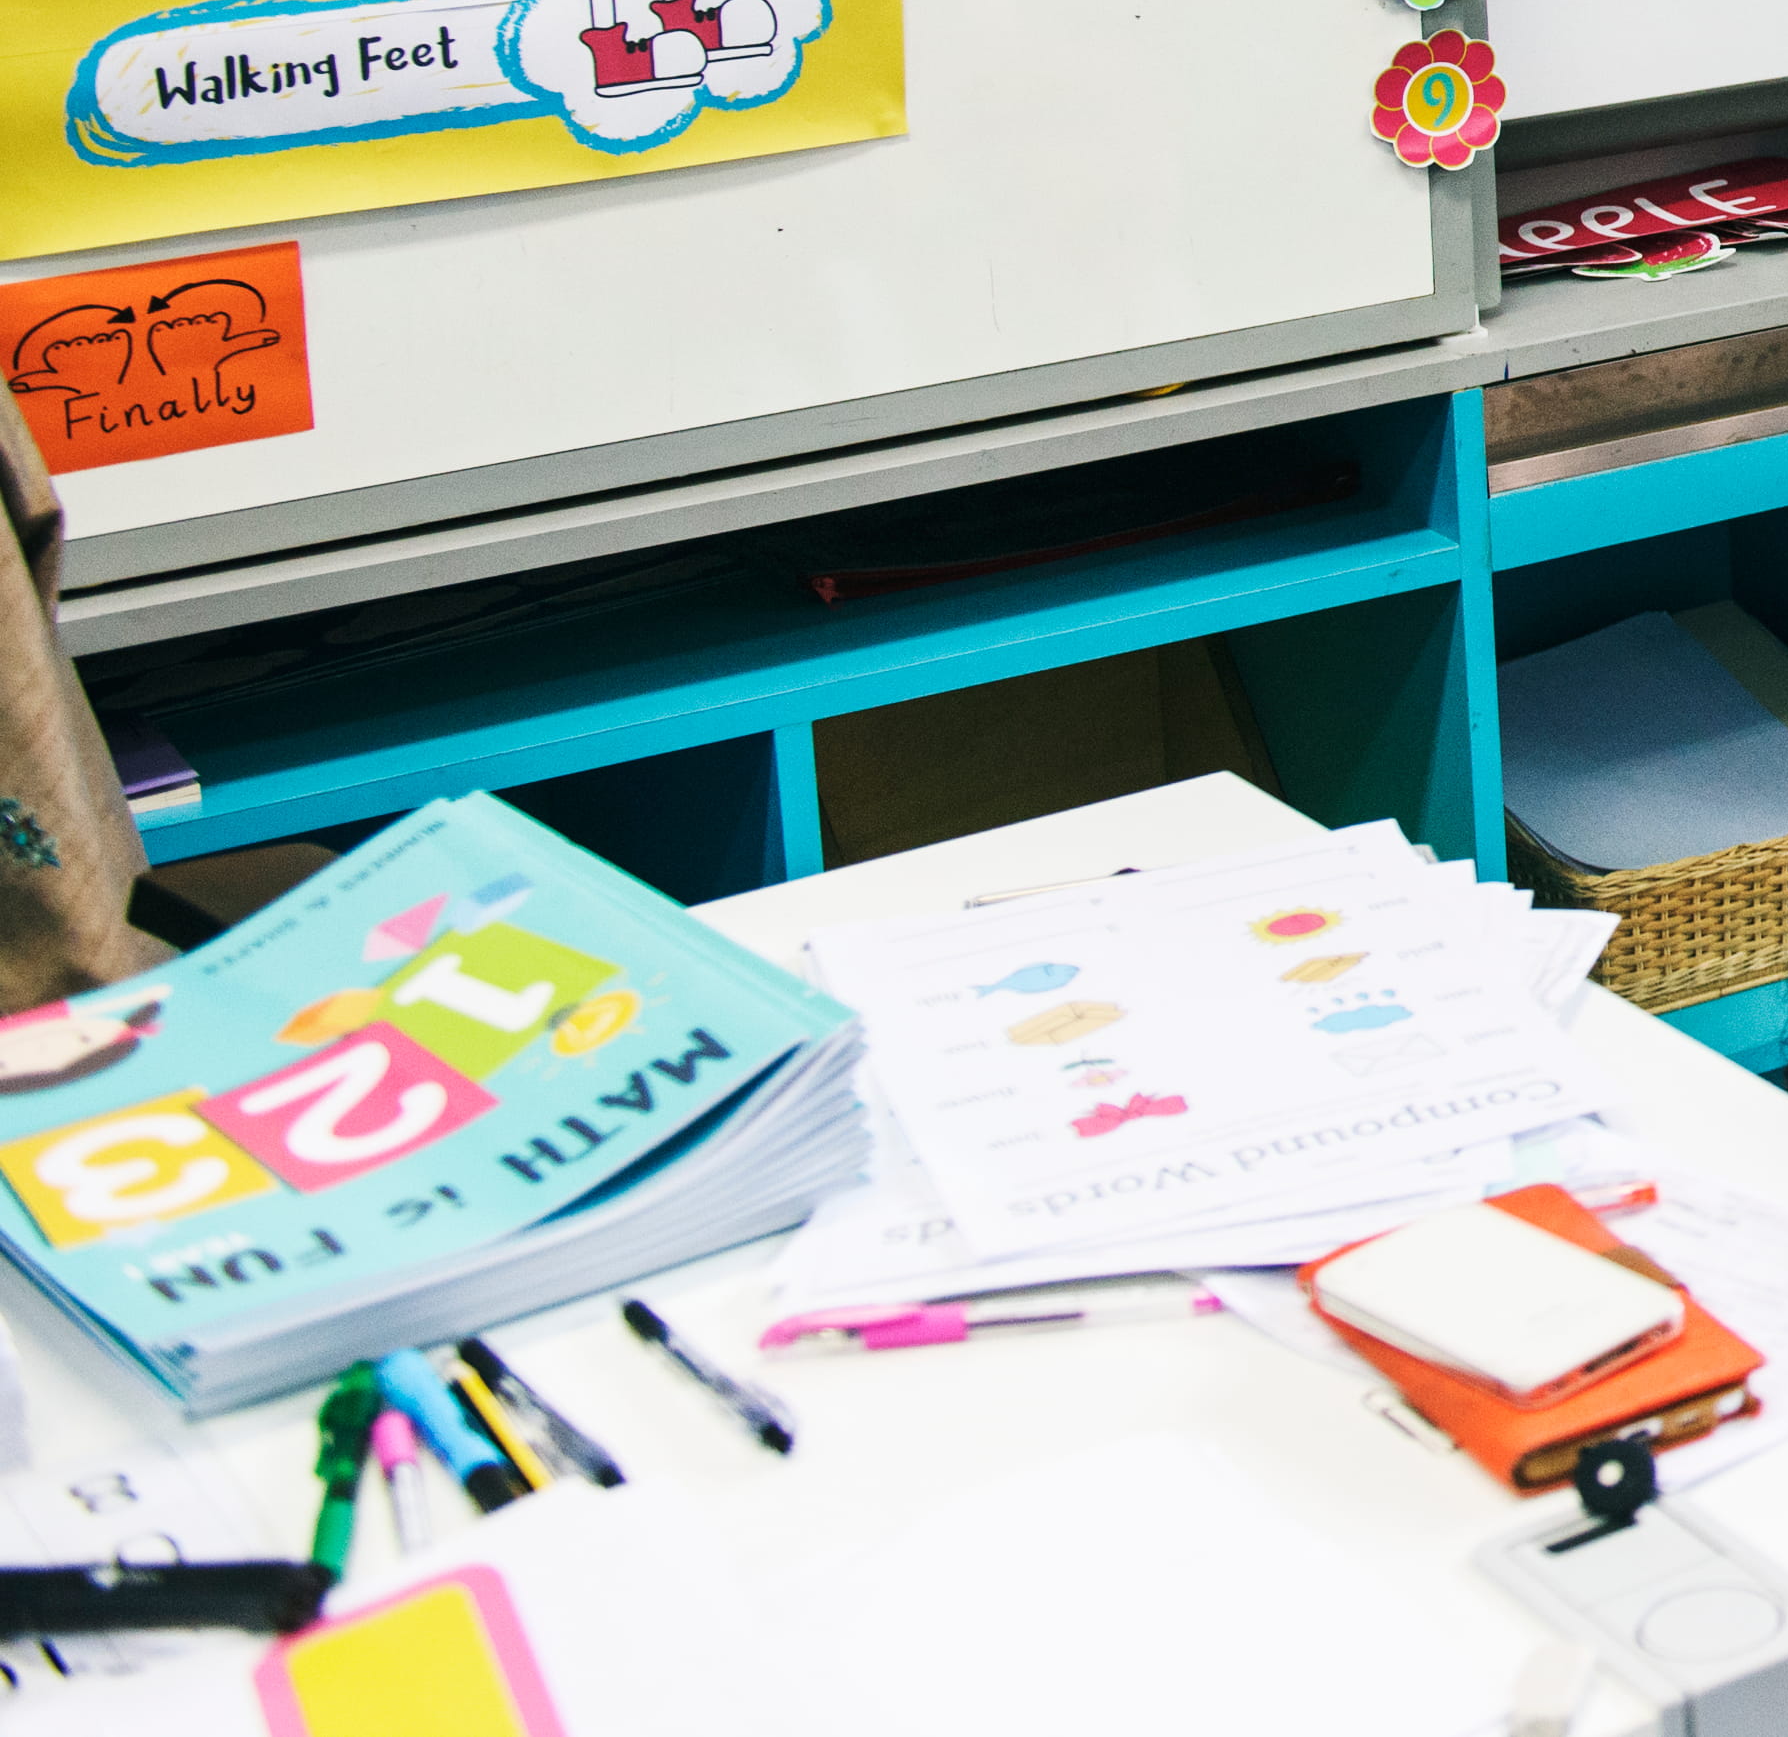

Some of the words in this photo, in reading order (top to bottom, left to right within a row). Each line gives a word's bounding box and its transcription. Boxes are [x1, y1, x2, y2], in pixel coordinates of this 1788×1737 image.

[155, 53, 341, 112] Walking
[358, 26, 459, 83] Feet
[1421, 71, 1456, 128] 9
[1500, 178, 1778, 256] PPLE
[63, 371, 257, 443] Finally
[238, 1039, 450, 1165] 2
[498, 1027, 732, 1185] MATH
[1234, 1076, 1565, 1177] Compound
[37, 1111, 230, 1223] 3
[1005, 1160, 1222, 1221] Words
[386, 1184, 468, 1230] is
[144, 1227, 346, 1305] FUN
